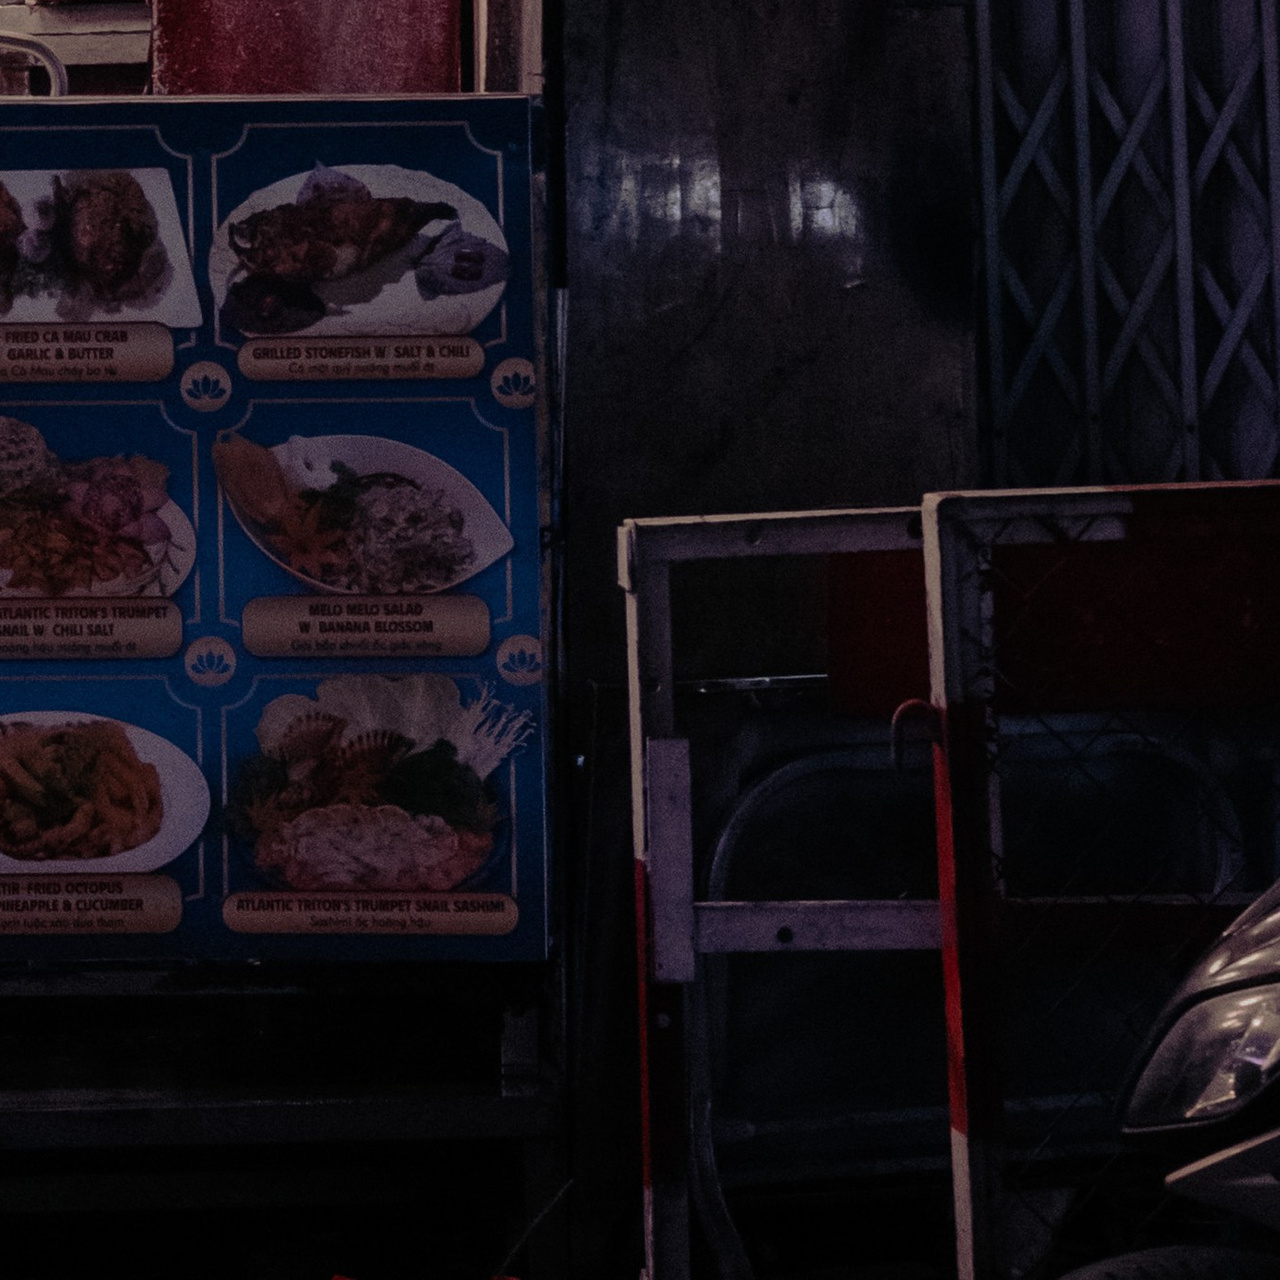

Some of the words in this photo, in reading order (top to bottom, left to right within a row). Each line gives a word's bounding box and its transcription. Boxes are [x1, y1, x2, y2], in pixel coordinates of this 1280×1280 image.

[43, 331, 59, 343] CA
[63, 331, 91, 342] MAU
[95, 331, 128, 342] CRAB
[7, 349, 50, 360] GARLIC
[55, 349, 63, 360] &
[68, 348, 113, 359] BUTTER
[253, 348, 300, 359] GRILLED
[306, 348, 370, 358] STONEFISH
[394, 347, 421, 358] SALT
[427, 347, 434, 358] &
[439, 347, 469, 357] CHILI
[112, 607, 168, 618] TRUMPET
[309, 604, 342, 615] MELO
[347, 604, 379, 615] MELO
[384, 604, 422, 615] SALAD
[53, 624, 83, 636] CHILI
[88, 624, 114, 635] SALT
[319, 621, 370, 632] BANANA
[375, 621, 433, 632] BLOSSOM
[66, 882, 123, 894] OCTOPUS
[63, 900, 71, 912] &
[76, 900, 143, 911] CUCUMBER
[237, 900, 293, 911] ATLANTIC
[355, 900, 412, 911] TRUMPET
[416, 900, 449, 911] SNAIL
[454, 900, 504, 911] SASHIMI
